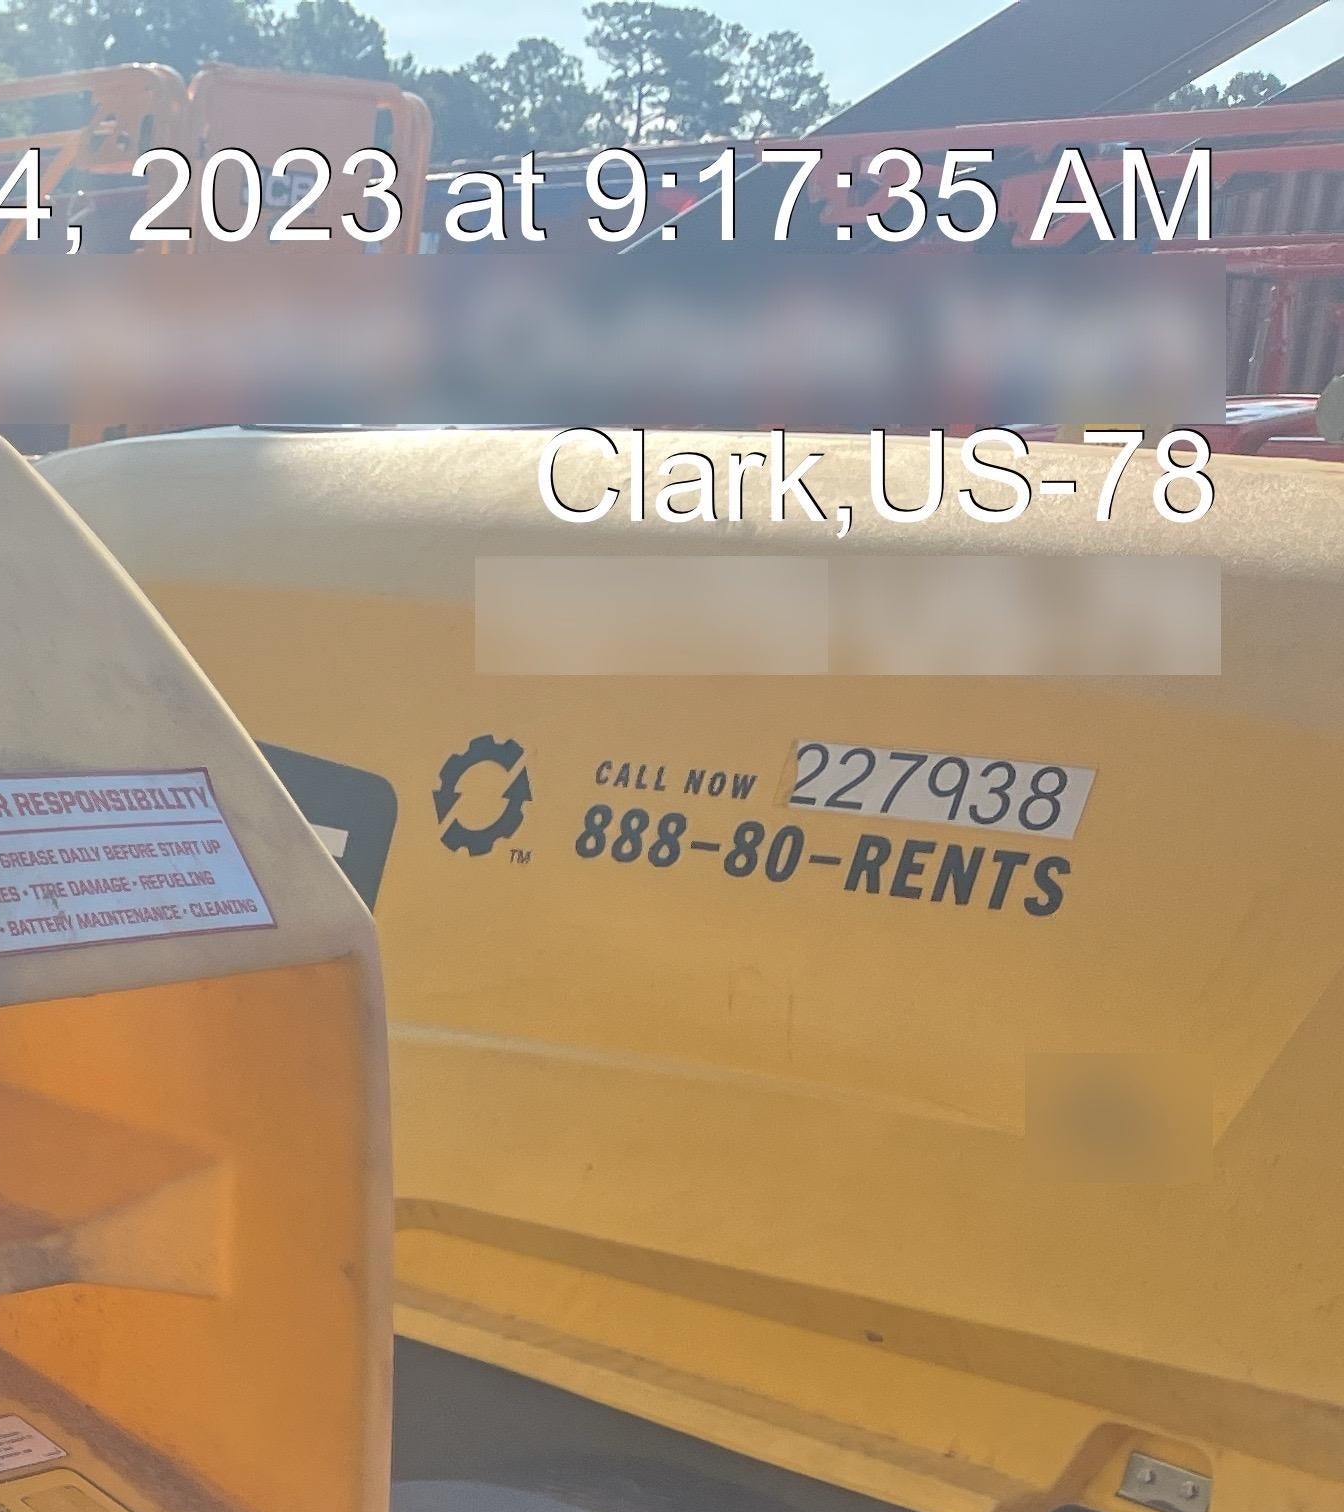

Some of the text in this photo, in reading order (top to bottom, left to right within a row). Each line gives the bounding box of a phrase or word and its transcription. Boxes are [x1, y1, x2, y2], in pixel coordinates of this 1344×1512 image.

[594, 759, 759, 800] CALL NOW
[787, 742, 1069, 832] 227938
[12, 786, 211, 817] RESPONSIBILITY
[0, 848, 59, 870] GREASE
[62, 845, 103, 865] DAILY
[103, 842, 155, 861] BEFORE
[159, 840, 198, 858] START
[201, 838, 222, 855] UP
[574, 802, 1072, 918] 888-80-RENTS
[29, 881, 66, 900] TIRE
[67, 876, 132, 896] DAMAGE
[138, 870, 217, 891] REFUELING
[7, 914, 73, 937] BATTERY
[76, 904, 183, 930] MAINTENANCE
[190, 899, 259, 919] CLEANING
